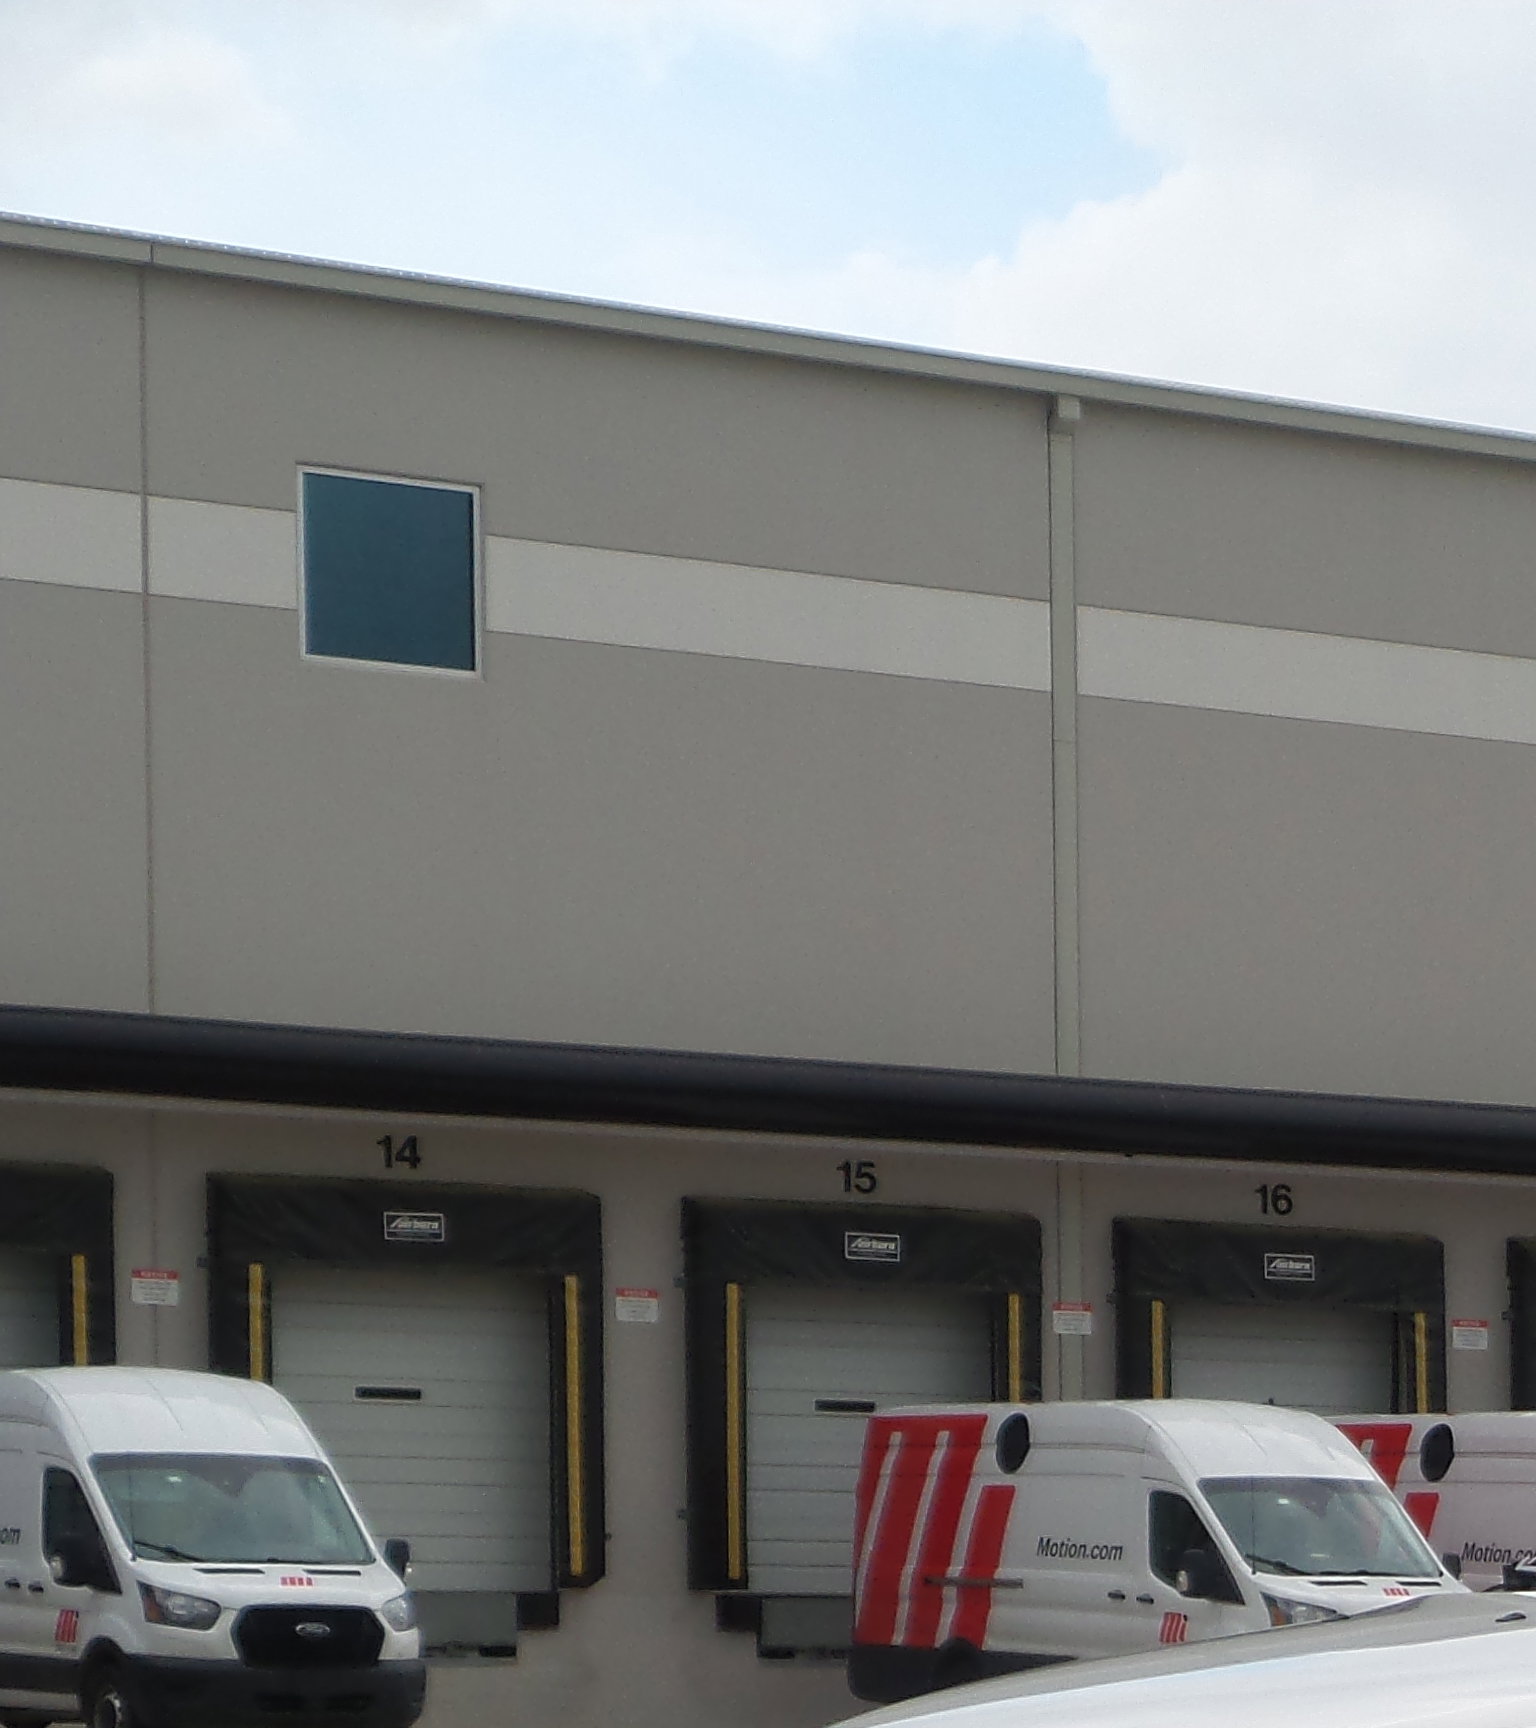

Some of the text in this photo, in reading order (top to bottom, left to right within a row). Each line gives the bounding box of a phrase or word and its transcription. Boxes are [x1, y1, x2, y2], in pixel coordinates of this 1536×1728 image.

[376, 1134, 422, 1169] 14
[836, 1161, 877, 1194] 15
[1254, 1184, 1293, 1216] 16
[1036, 1536, 1124, 1561] Motion.com
